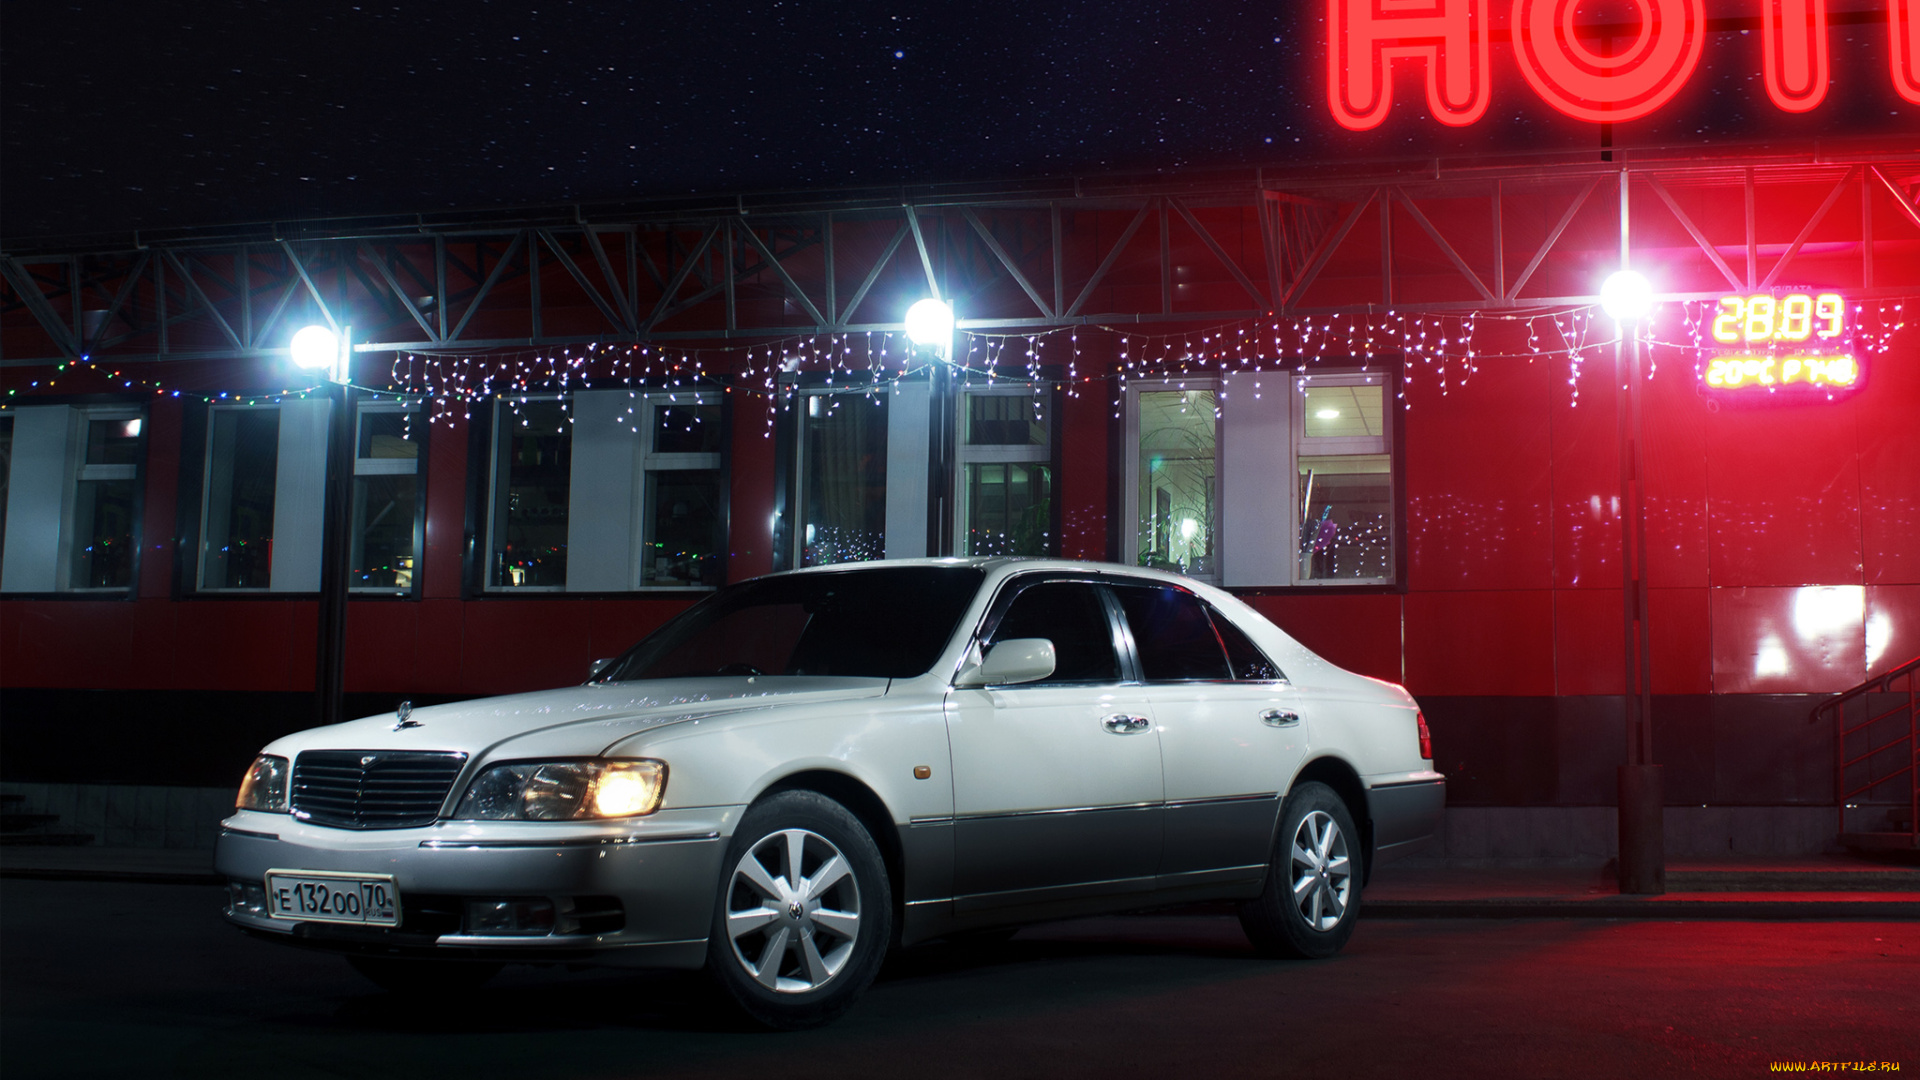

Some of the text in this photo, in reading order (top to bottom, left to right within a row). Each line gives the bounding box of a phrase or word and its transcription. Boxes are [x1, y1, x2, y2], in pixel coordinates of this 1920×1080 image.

[1326, 0, 1920, 132] HO
[362, 883, 386, 908] 70
[365, 908, 382, 918] RUS
